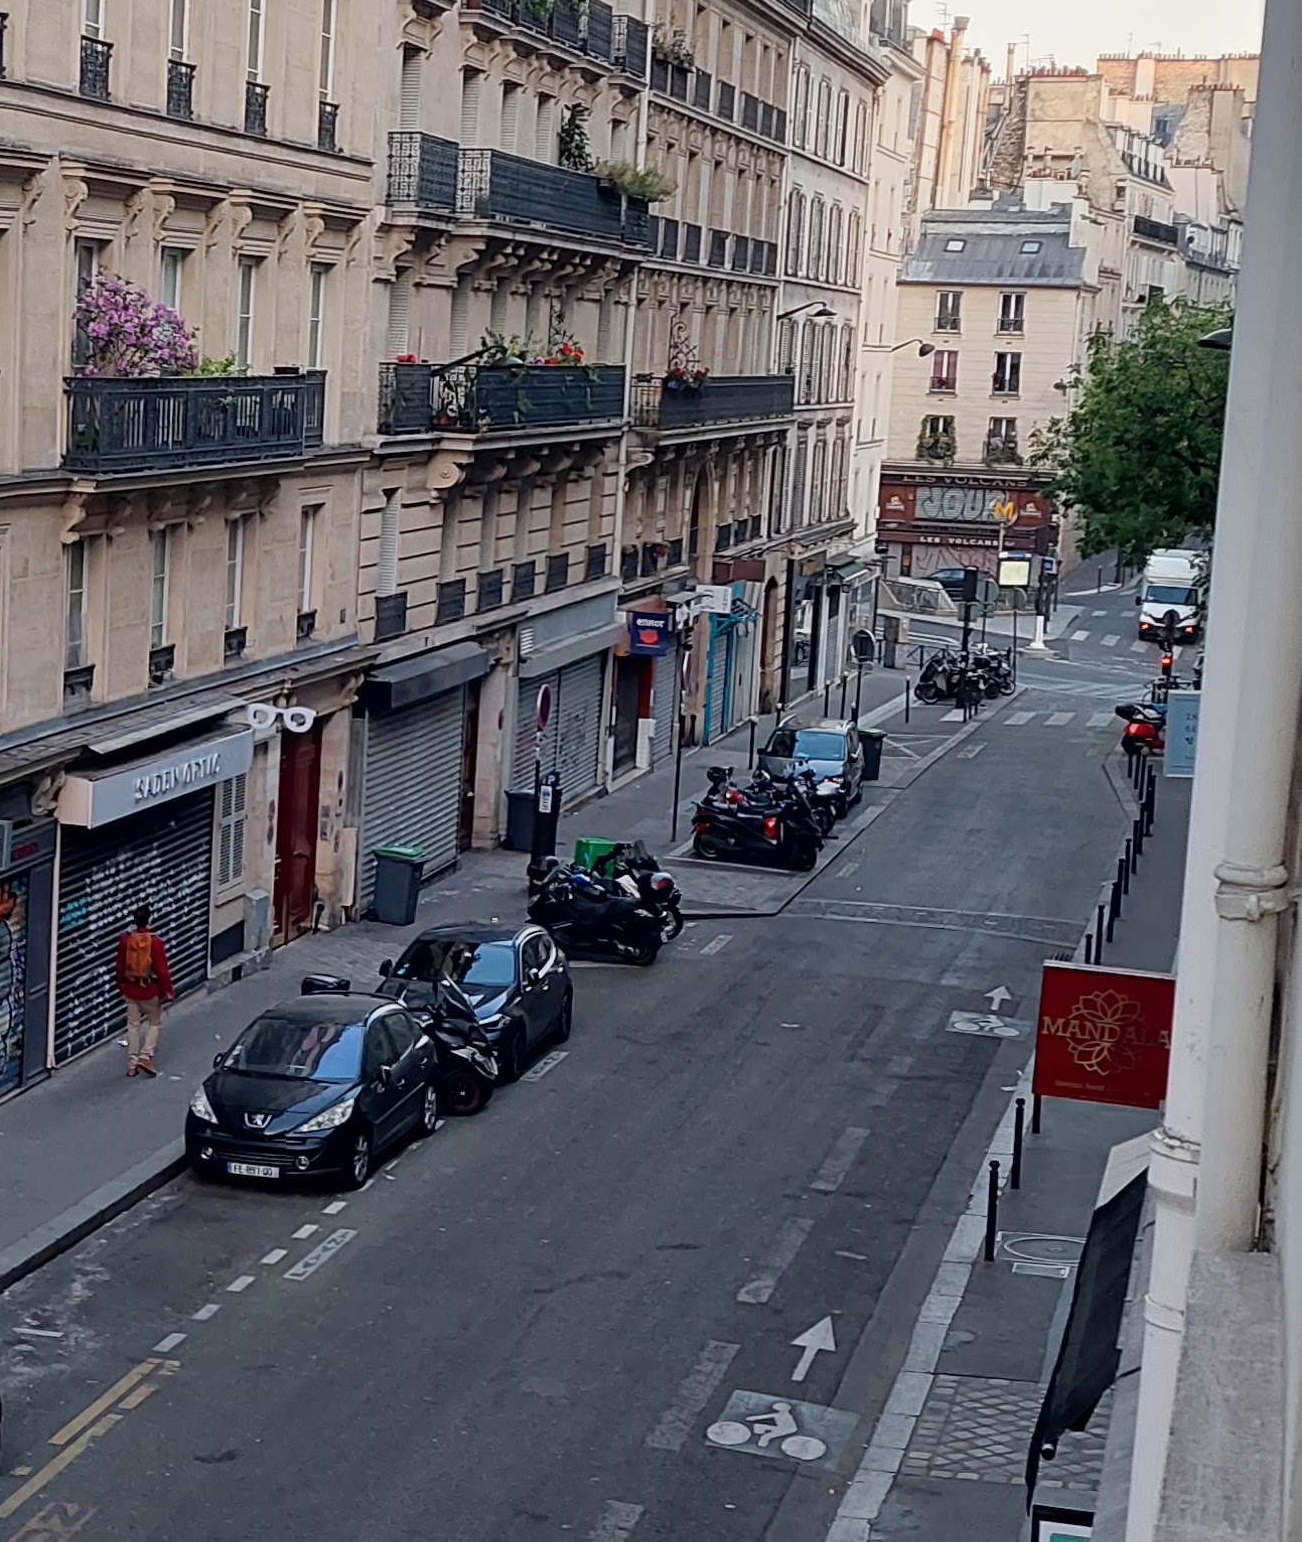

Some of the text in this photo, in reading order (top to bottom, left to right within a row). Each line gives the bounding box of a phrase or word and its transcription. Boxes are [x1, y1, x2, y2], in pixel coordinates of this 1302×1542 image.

[992, 500, 1017, 521] M
[920, 536, 941, 544] LES
[948, 537, 999, 547] VOLCANS
[182, 752, 221, 783] OPTIC
